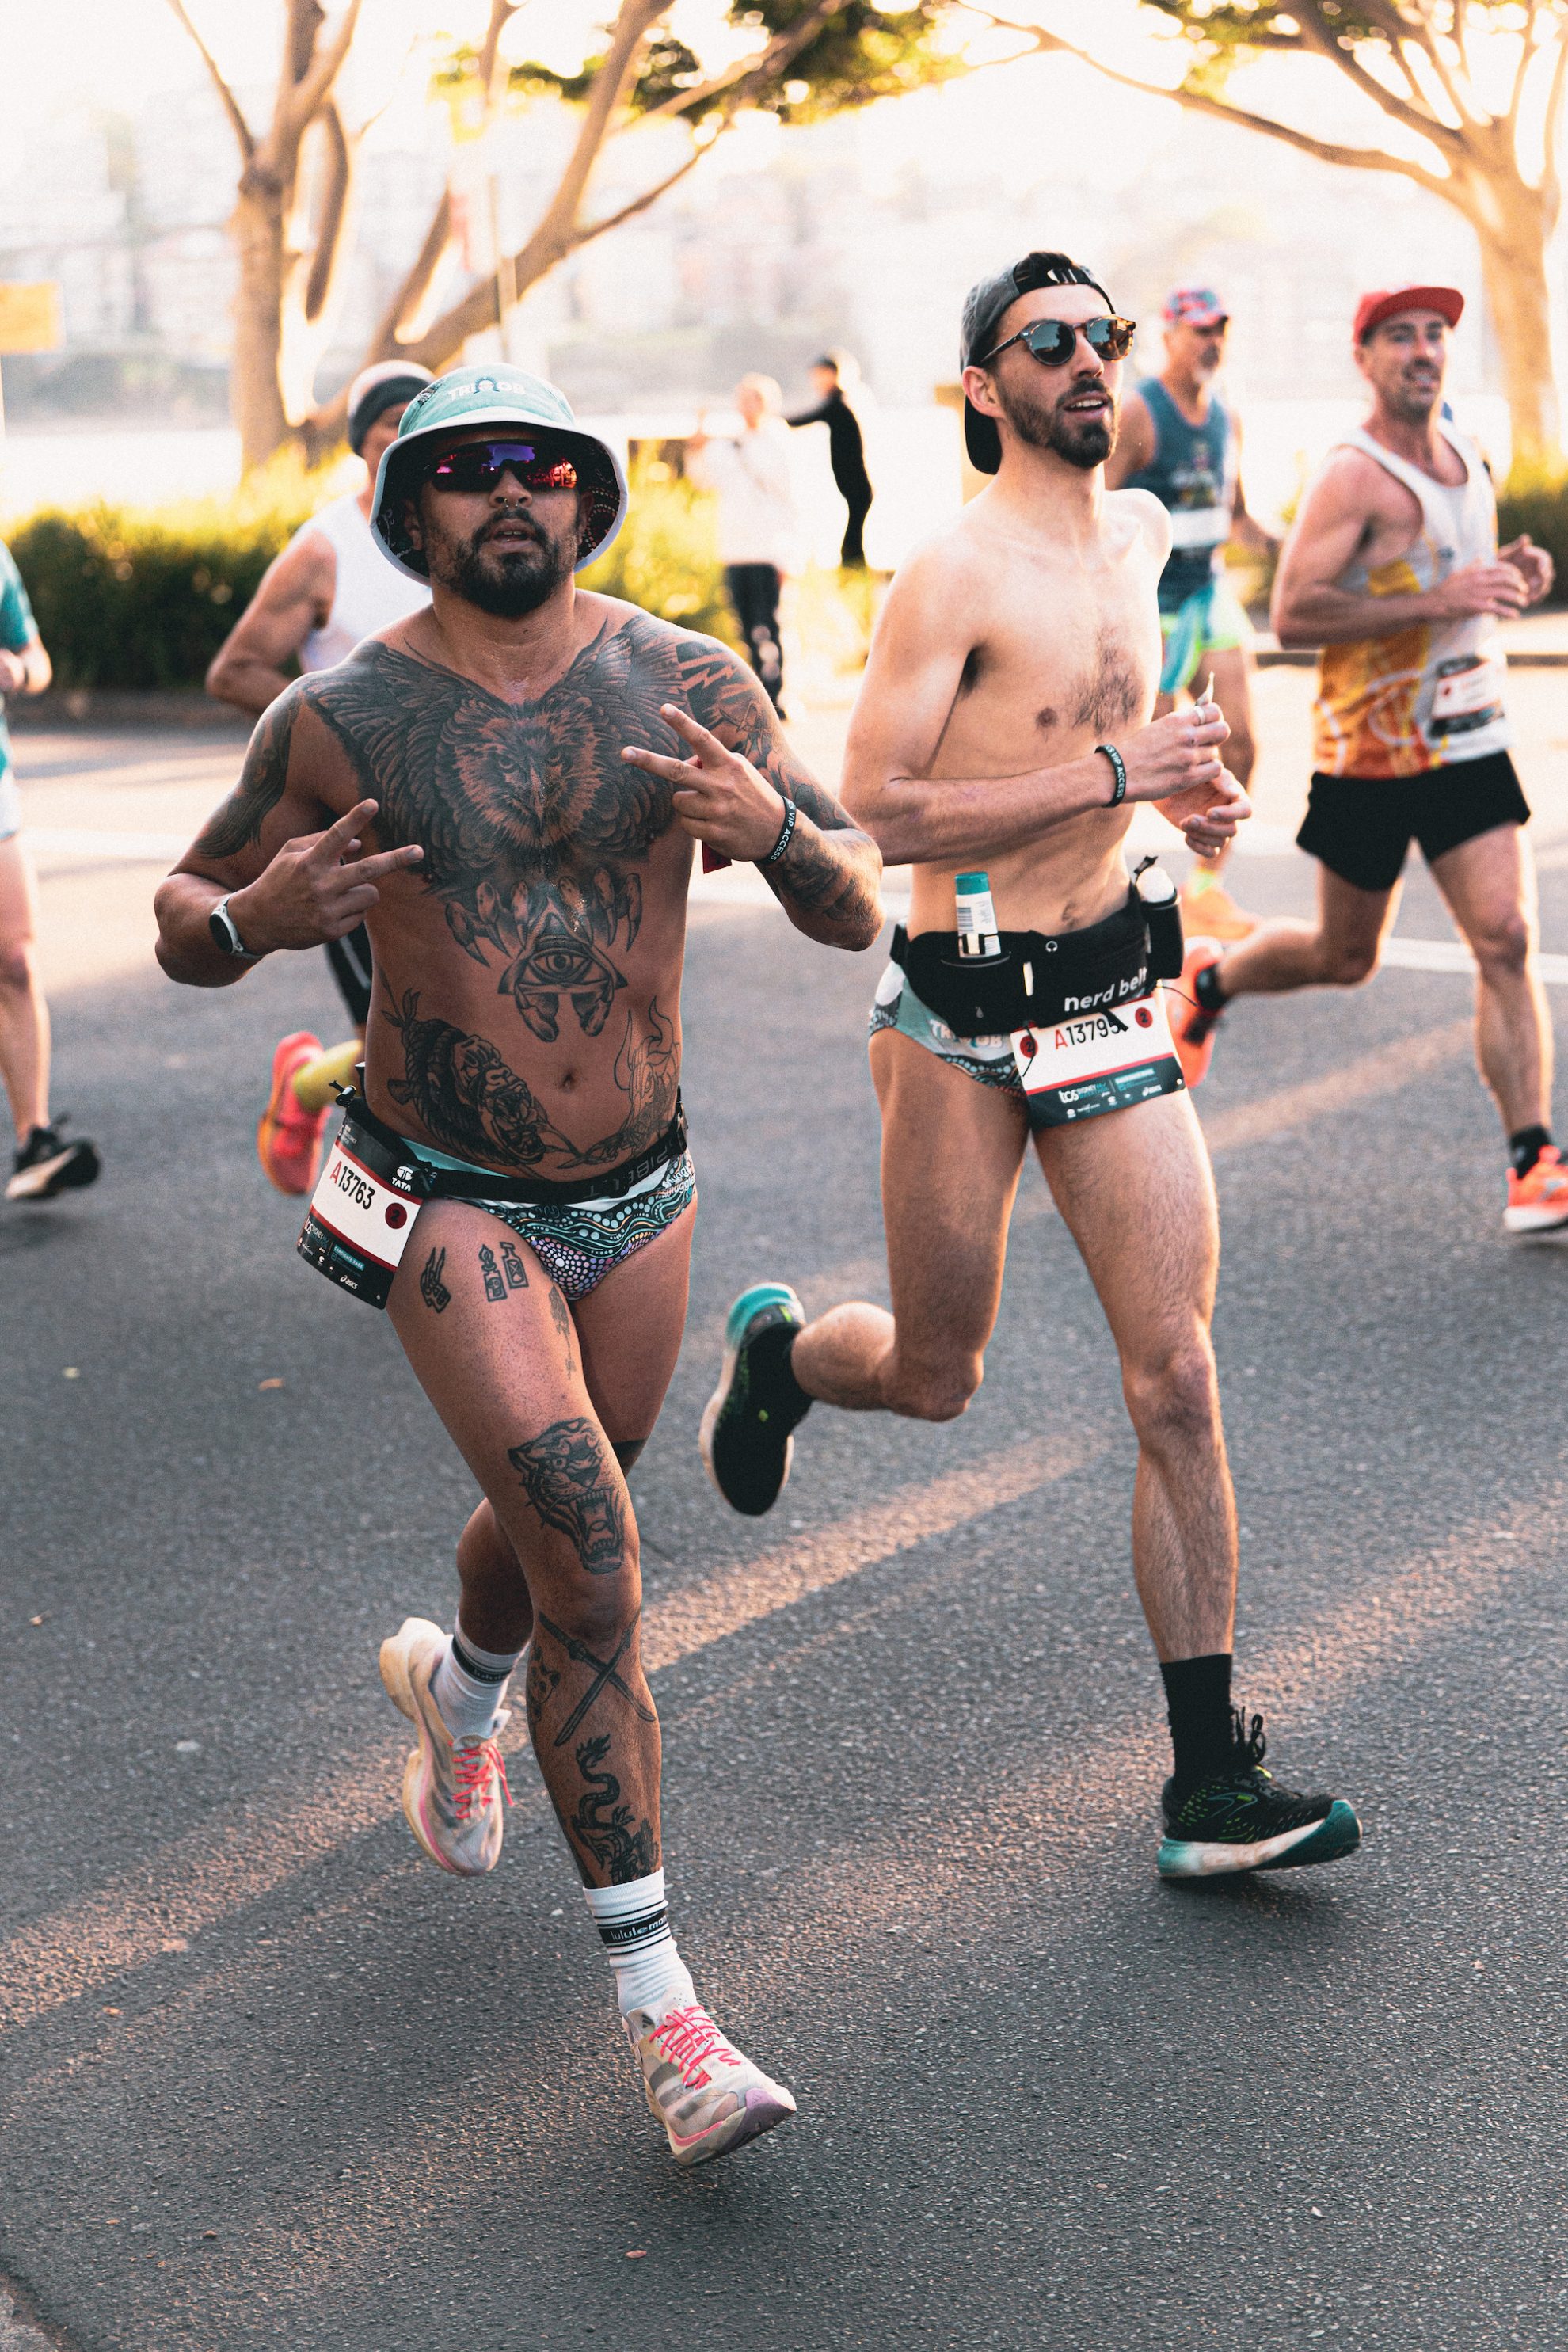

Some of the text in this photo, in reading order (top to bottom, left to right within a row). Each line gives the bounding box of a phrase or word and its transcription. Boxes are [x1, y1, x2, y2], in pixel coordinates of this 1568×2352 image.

[1110, 752, 1125, 798] VIP ACCESS
[787, 812, 796, 827] VIP
[771, 828, 791, 861] ACCESS
[1064, 966, 1147, 1012] nerd belt
[1058, 1090, 1079, 1104] tcs
[329, 1161, 376, 1210] A13763
[391, 1177, 412, 1193] TATA
